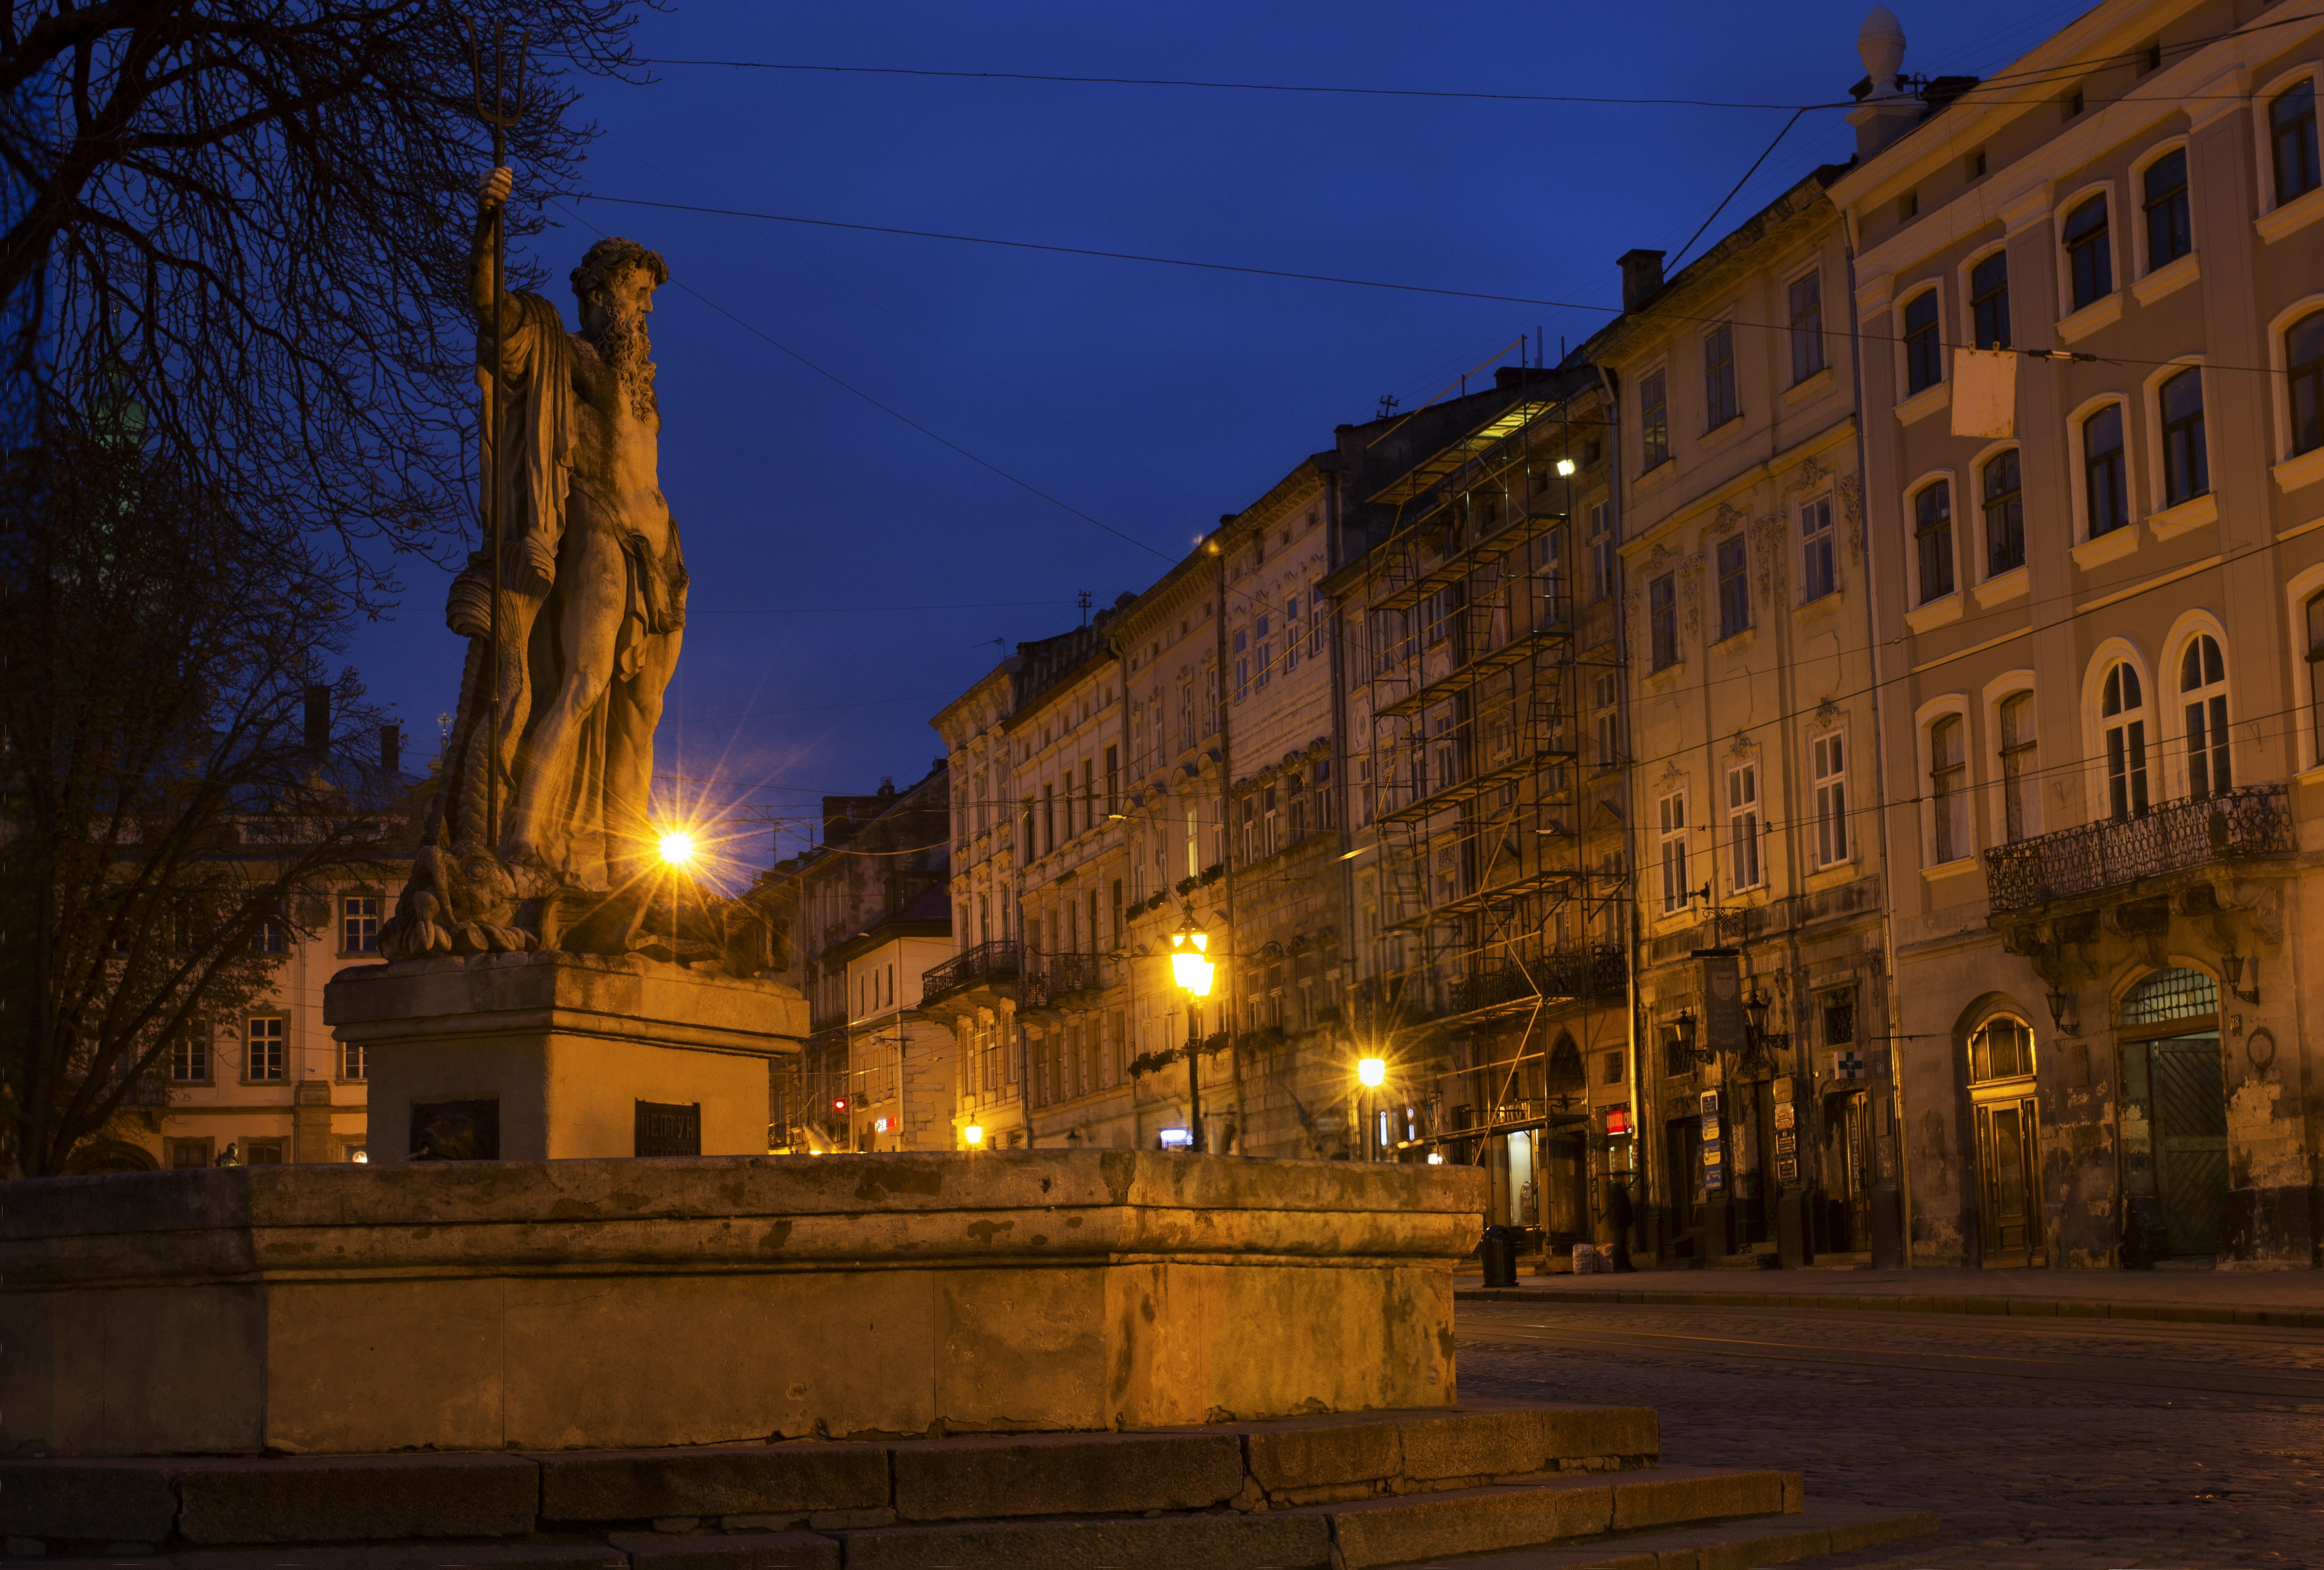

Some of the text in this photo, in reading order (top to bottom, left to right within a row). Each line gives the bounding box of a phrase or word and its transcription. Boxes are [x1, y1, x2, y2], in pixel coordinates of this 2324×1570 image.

[2231, 1015, 2239, 1028] 18
[640, 1114, 694, 1139] НЕПТУН
[1851, 1114, 1861, 1192] АПТЕКА
